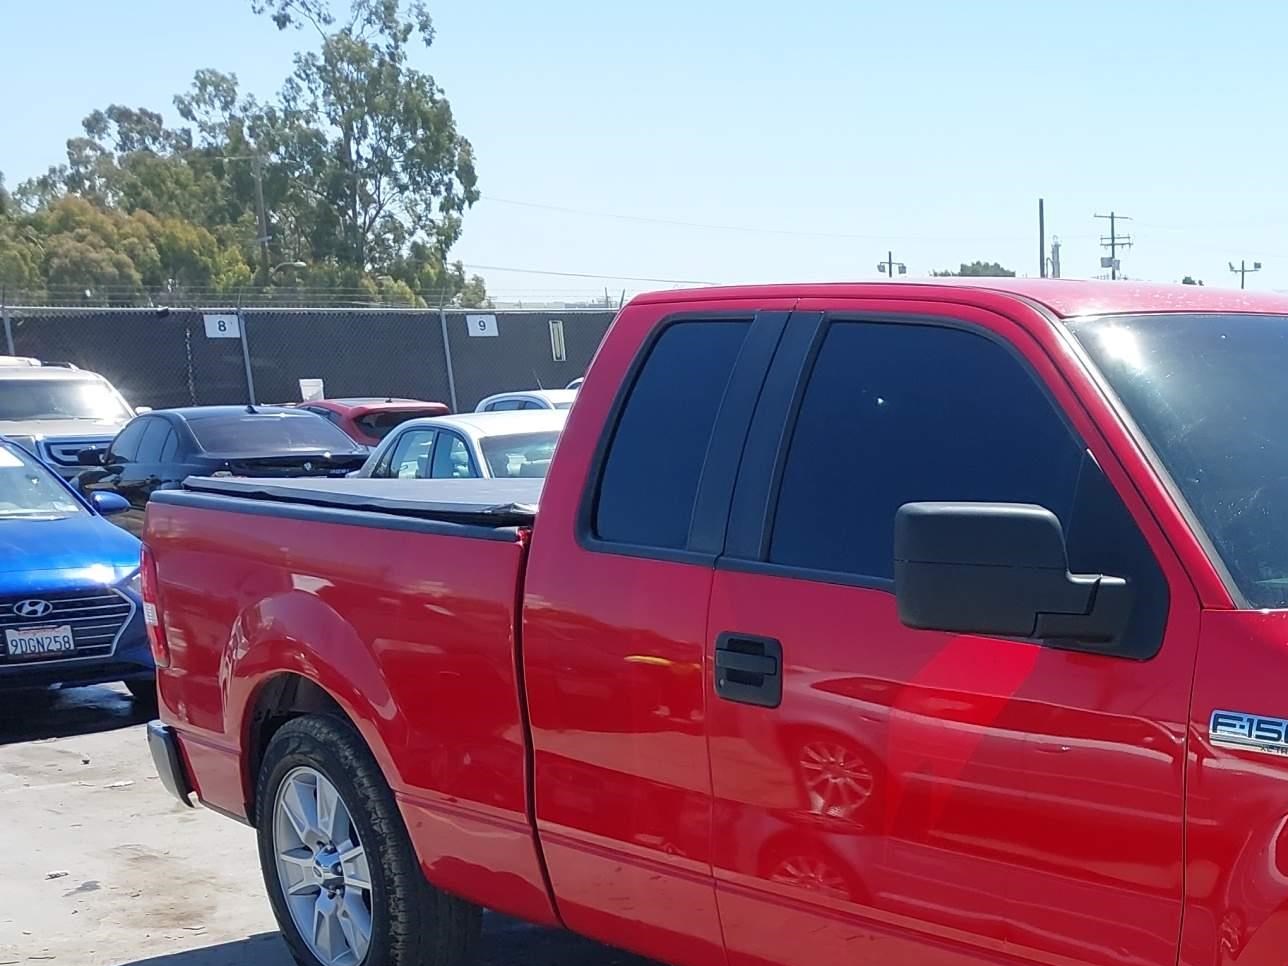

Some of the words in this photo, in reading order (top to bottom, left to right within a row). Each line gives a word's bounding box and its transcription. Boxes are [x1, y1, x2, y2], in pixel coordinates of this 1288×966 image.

[217, 319, 227, 332] 8
[478, 319, 487, 331] 9
[10, 634, 72, 655] 9DGN258
